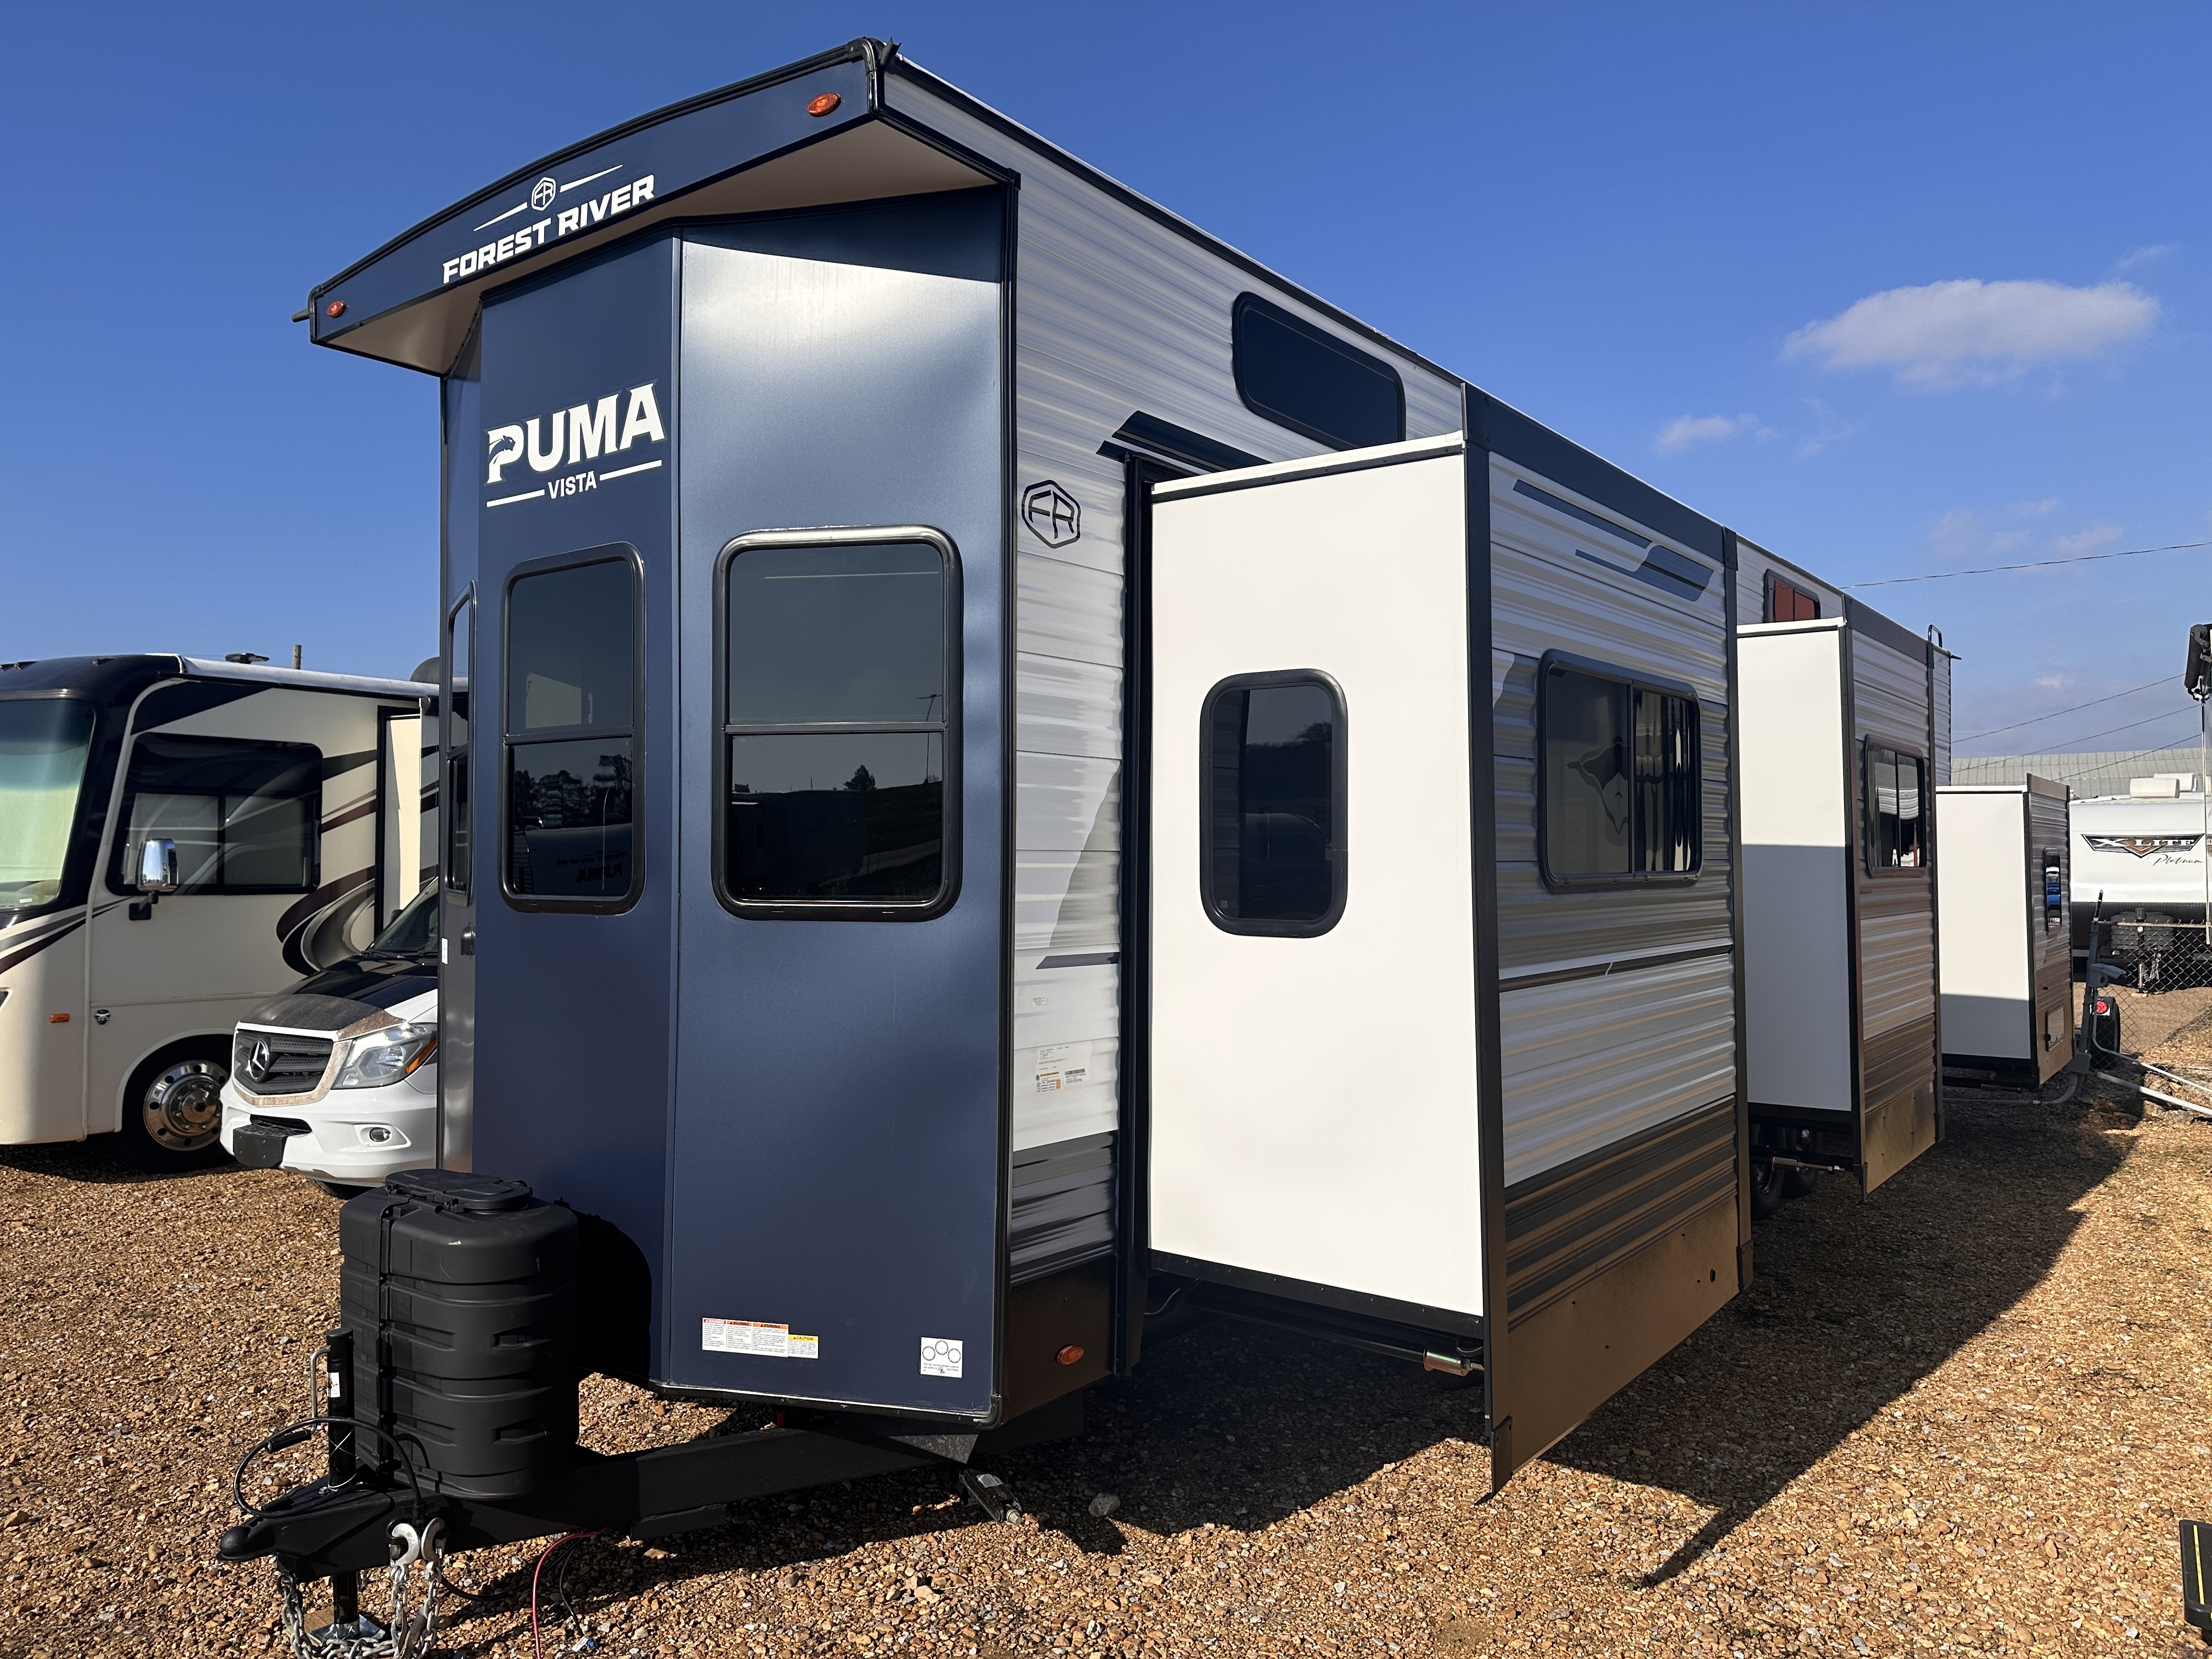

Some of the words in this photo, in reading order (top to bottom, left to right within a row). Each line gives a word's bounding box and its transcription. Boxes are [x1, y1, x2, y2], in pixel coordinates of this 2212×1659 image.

[443, 218, 551, 284] FOREST
[557, 175, 654, 236] RIVER
[487, 383, 665, 484] PUMA
[548, 471, 597, 499] VISTA
[2147, 853, 2204, 866] Platinum
